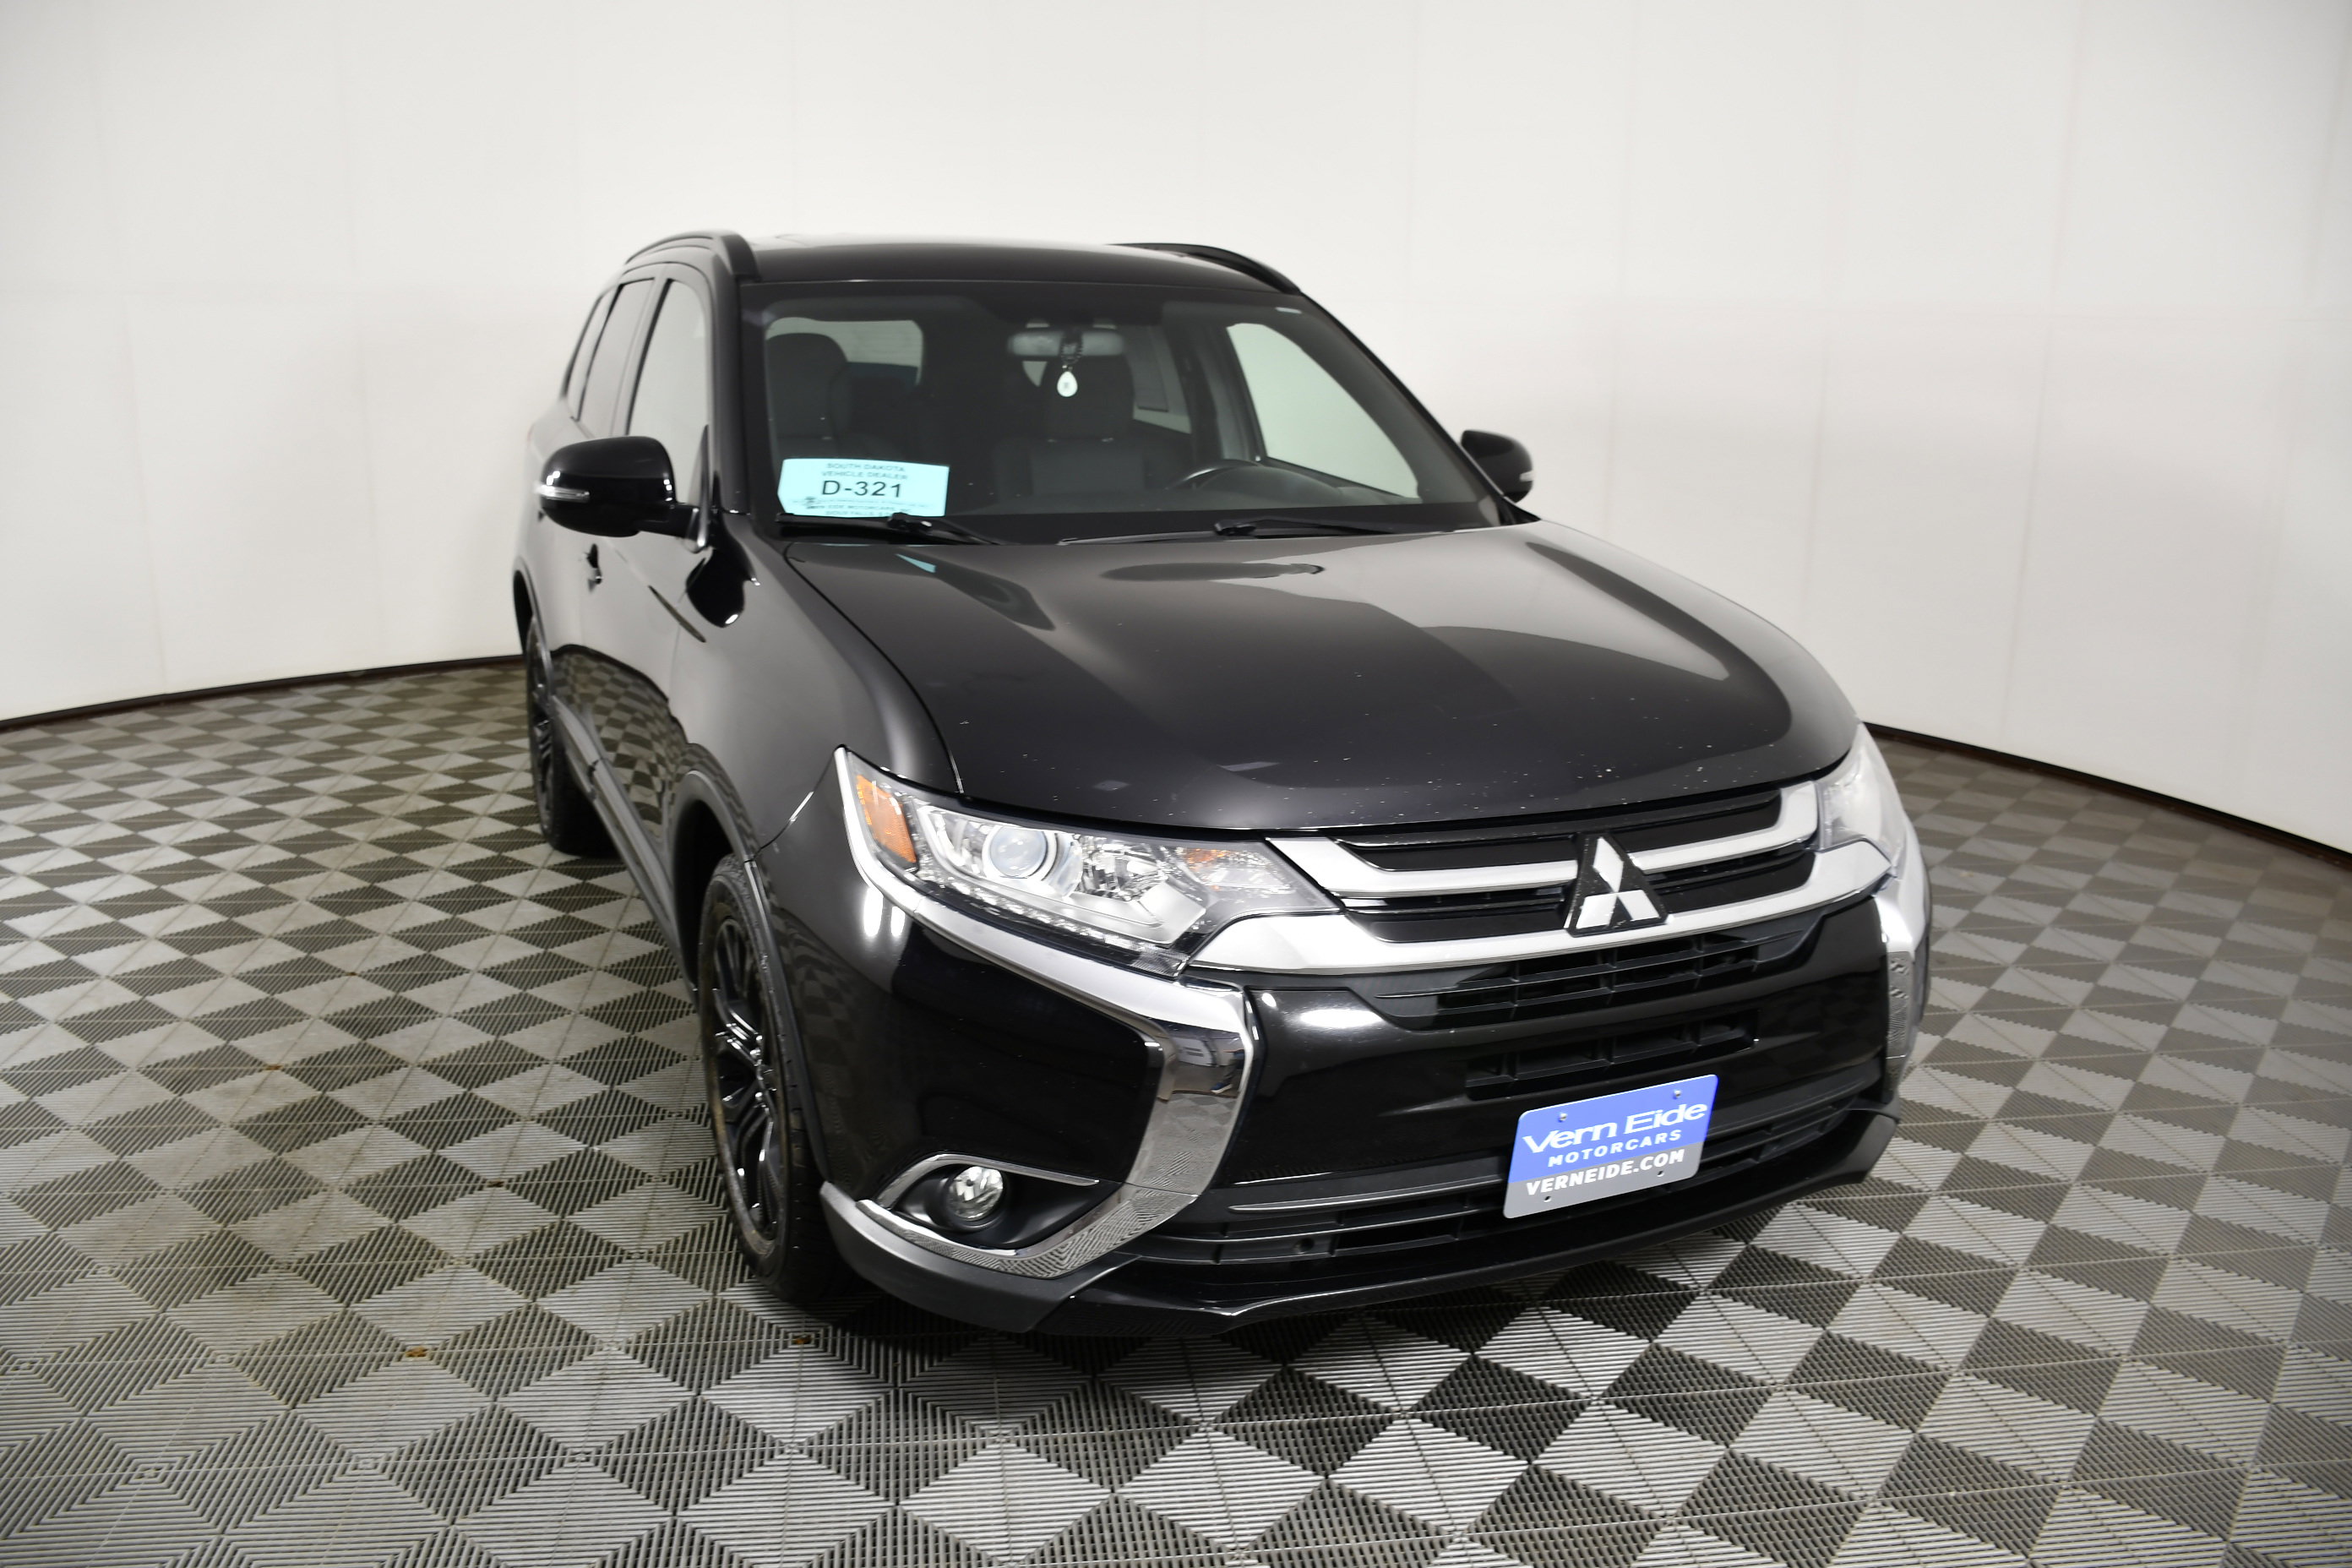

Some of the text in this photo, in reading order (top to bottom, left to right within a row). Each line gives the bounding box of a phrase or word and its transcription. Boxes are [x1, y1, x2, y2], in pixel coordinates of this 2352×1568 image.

[822, 480, 901, 498] D-321
[1522, 1103, 1707, 1154] Vern Eide
[1548, 1130, 1682, 1168] MOTORCARS
[1526, 1149, 1685, 1195] VERNEIDE.COM
